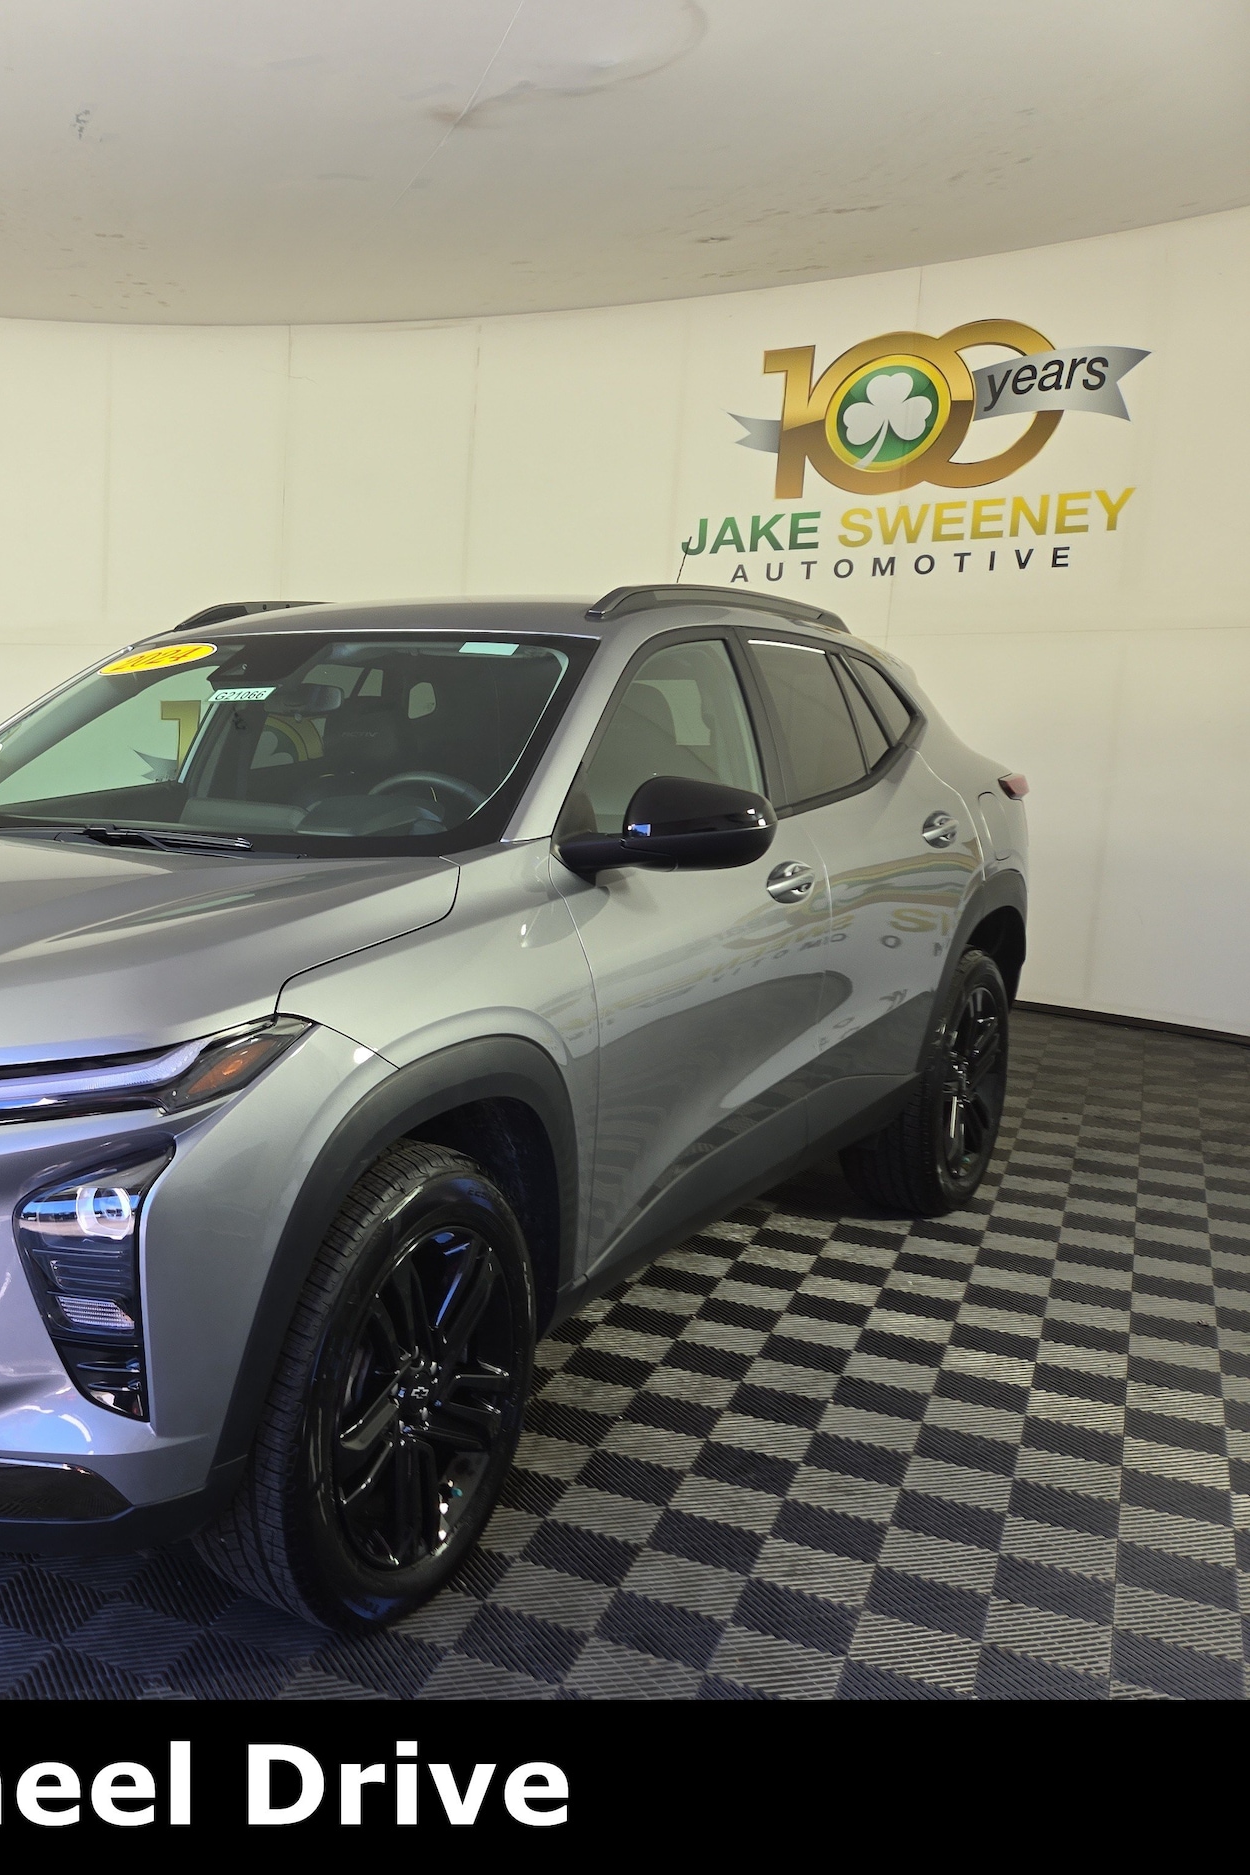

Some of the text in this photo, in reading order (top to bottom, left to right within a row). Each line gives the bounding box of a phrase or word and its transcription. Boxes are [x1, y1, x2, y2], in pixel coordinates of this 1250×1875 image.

[984, 356, 1110, 411] years
[681, 487, 1137, 556] JAKE SWEENEY
[730, 546, 1072, 584] AUTOMOTIVE
[214, 690, 265, 701] G21066
